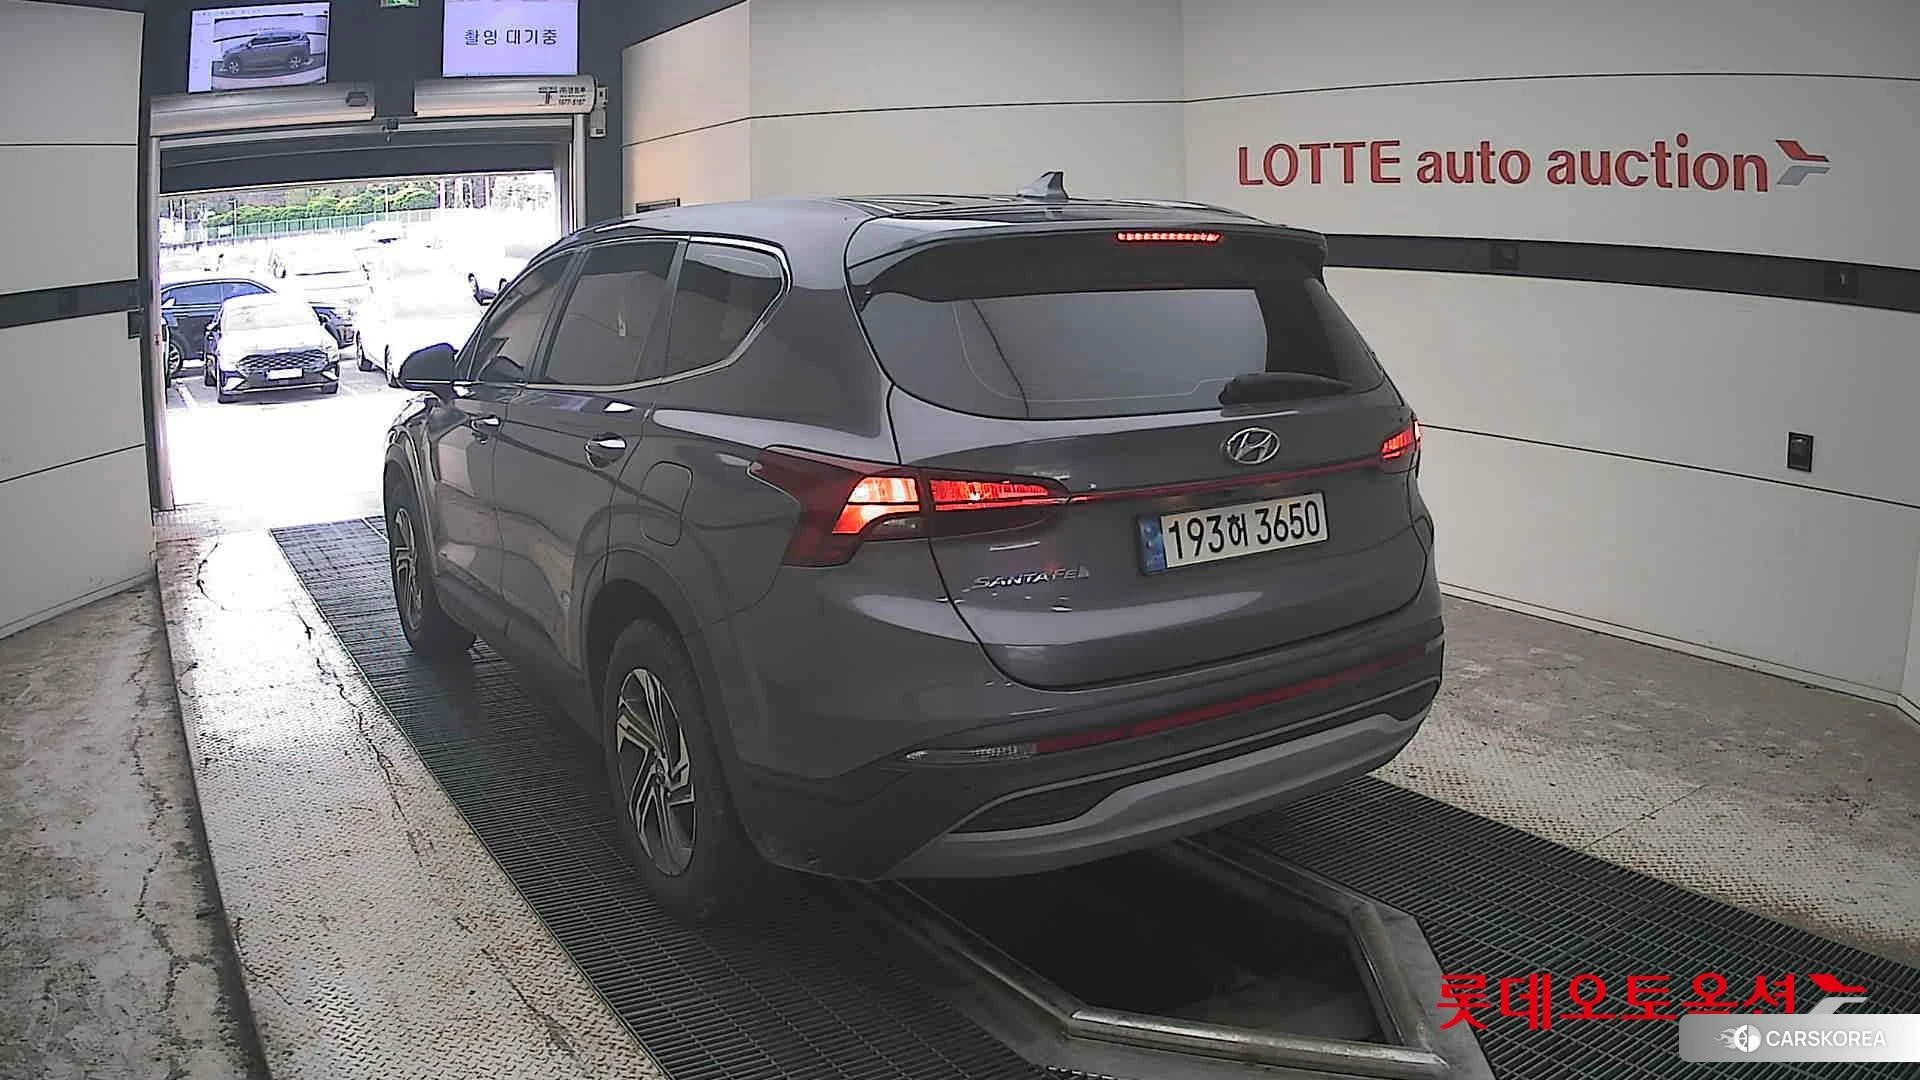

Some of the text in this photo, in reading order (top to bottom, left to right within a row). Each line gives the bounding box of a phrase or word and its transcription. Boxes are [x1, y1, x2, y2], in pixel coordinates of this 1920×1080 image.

[465, 29, 557, 46] 촬영 대기중
[1238, 132, 1769, 192] LOTTE auto auction
[1168, 500, 1320, 560] 193허 3650
[970, 572, 1050, 589] SANTA
